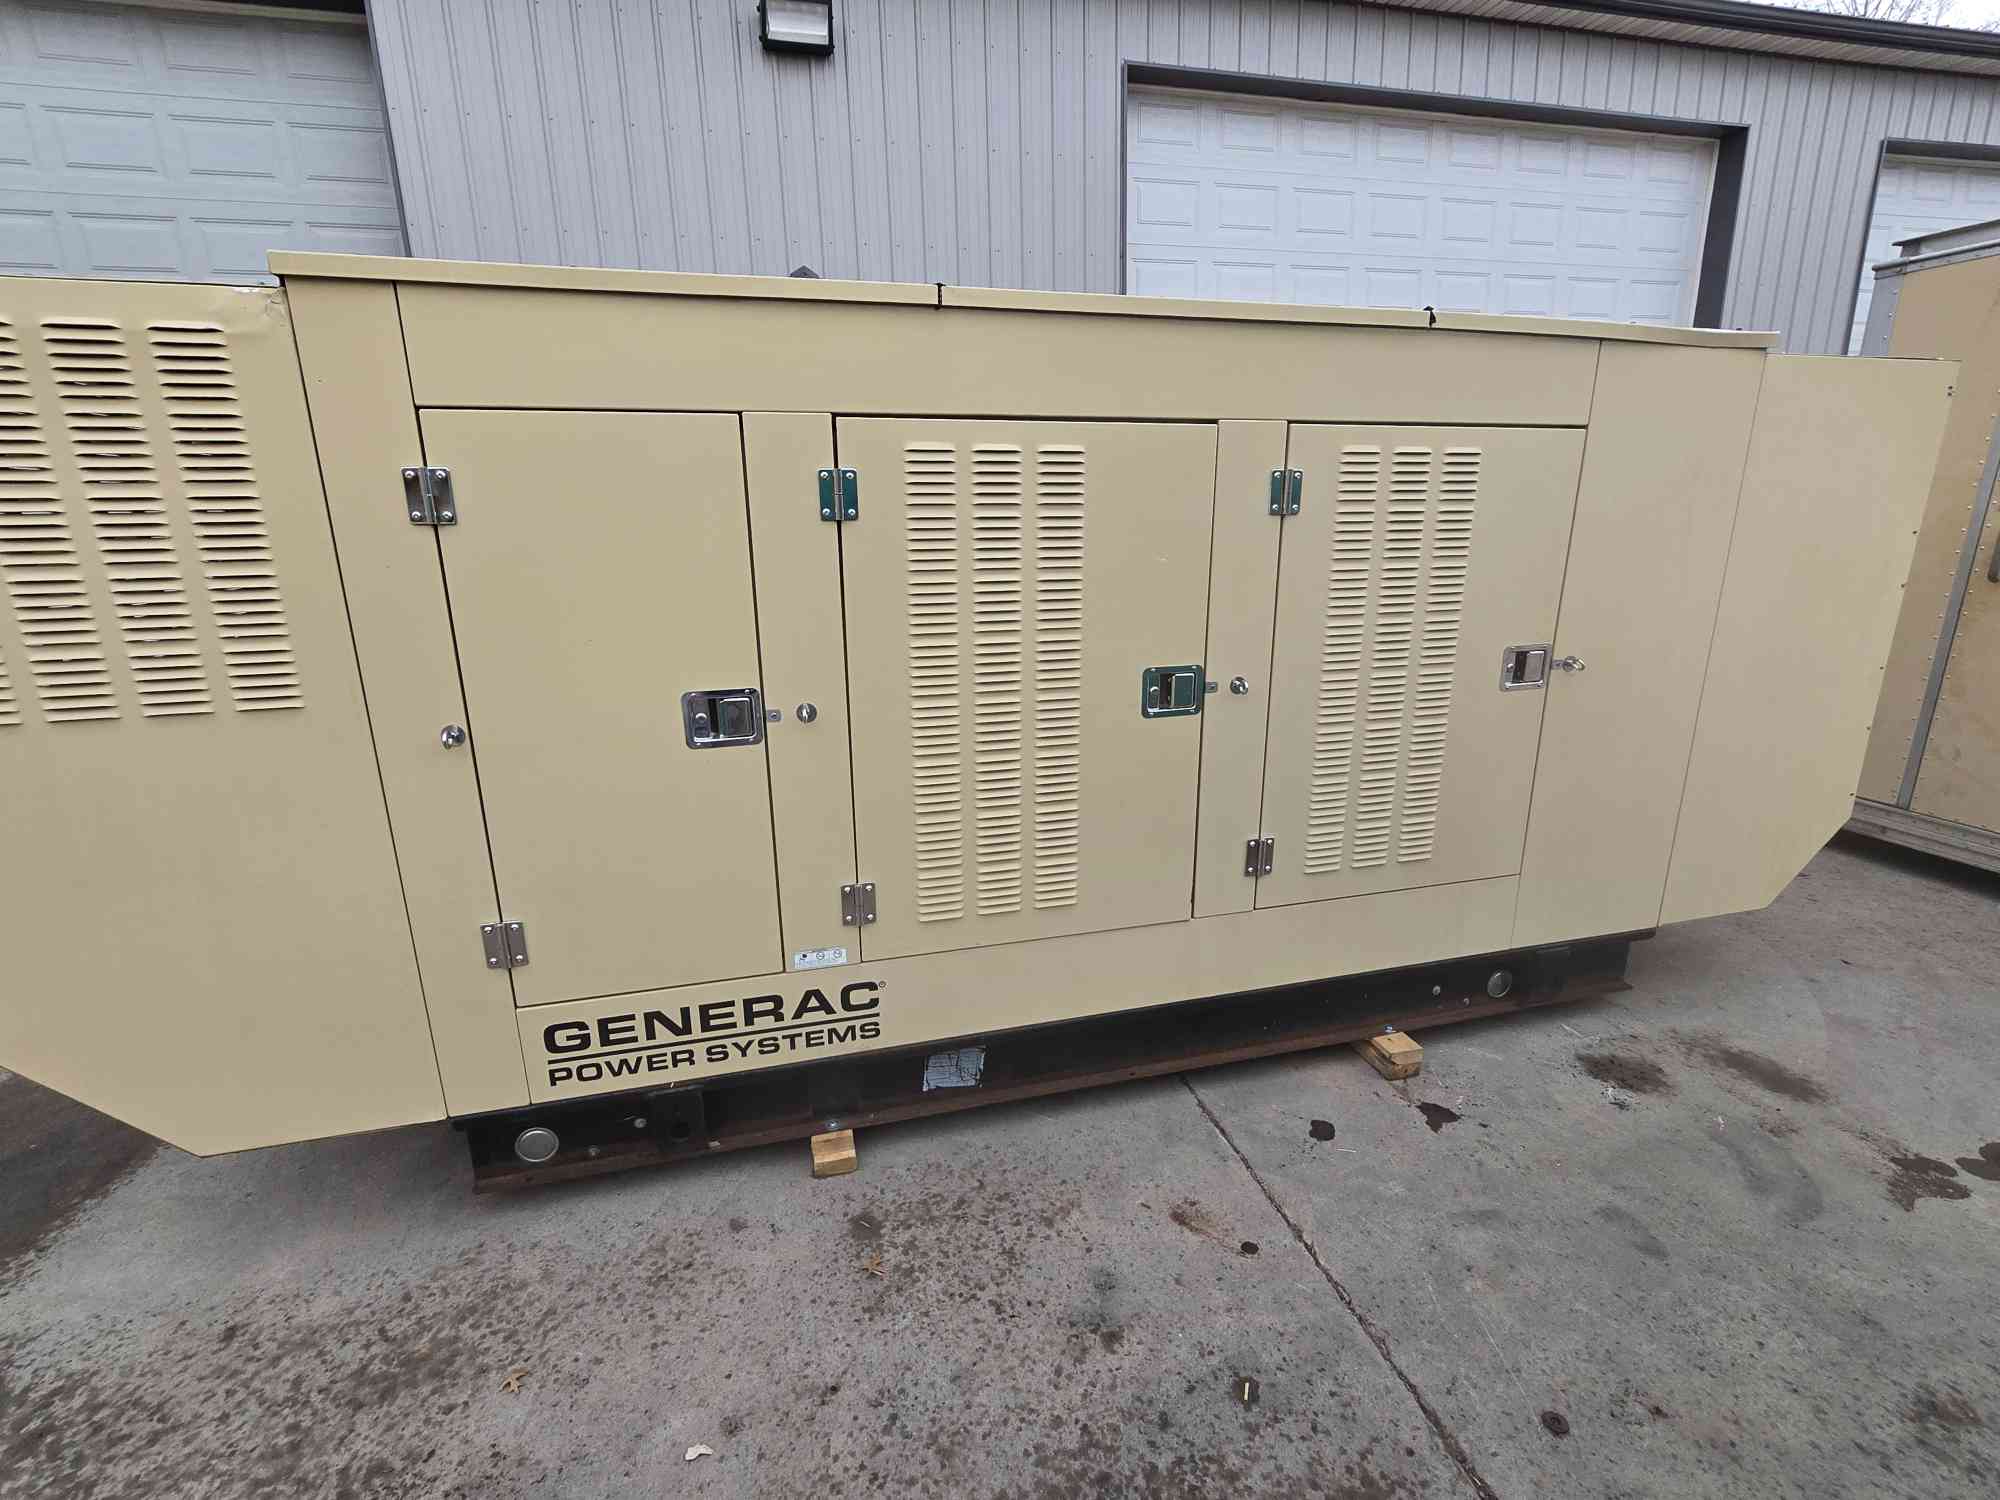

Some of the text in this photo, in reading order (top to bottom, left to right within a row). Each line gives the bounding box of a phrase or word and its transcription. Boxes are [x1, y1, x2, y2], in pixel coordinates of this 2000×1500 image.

[543, 981, 881, 1054] GENERAC
[548, 1021, 881, 1087] POWER SYSTEMS
